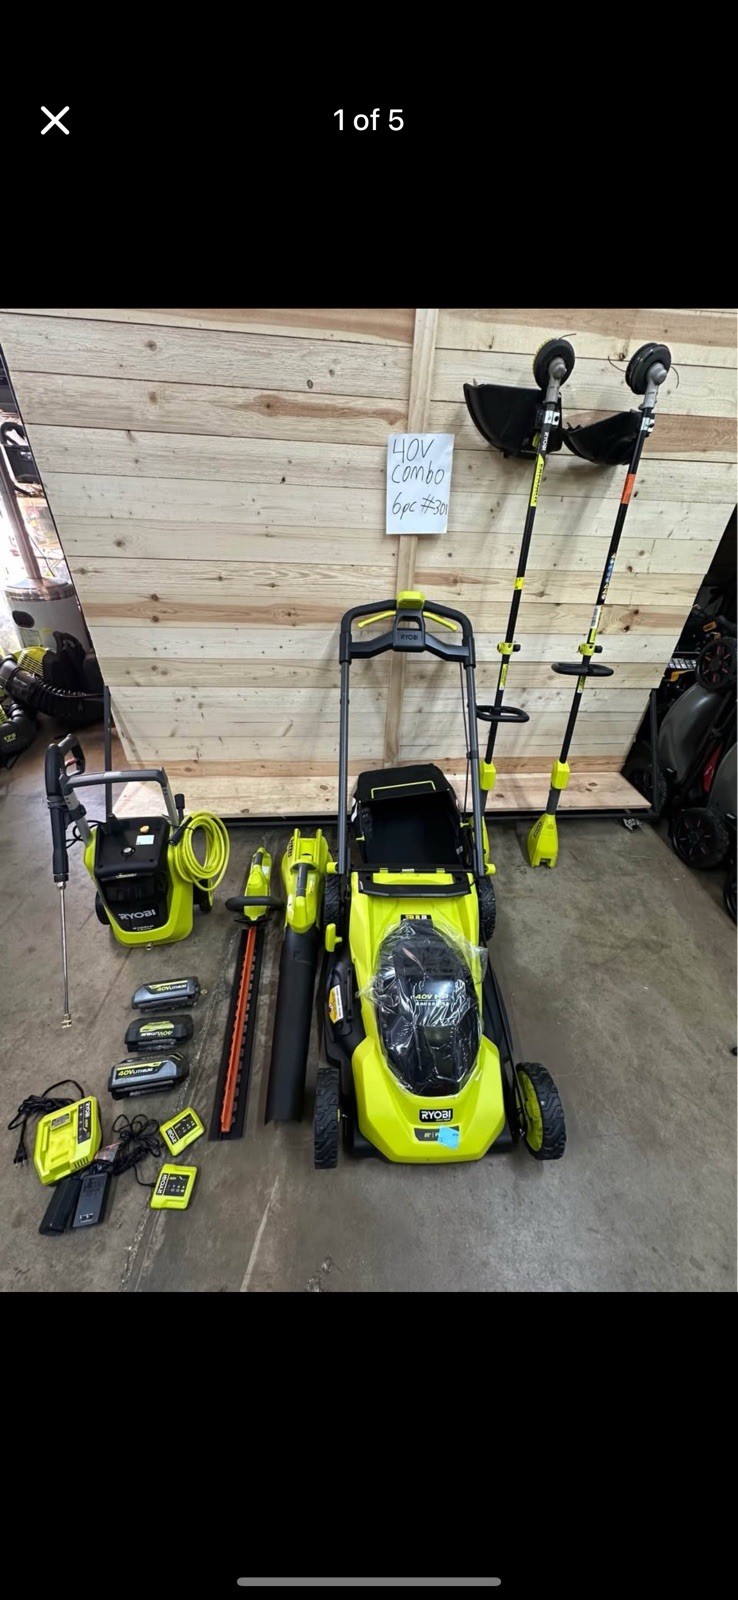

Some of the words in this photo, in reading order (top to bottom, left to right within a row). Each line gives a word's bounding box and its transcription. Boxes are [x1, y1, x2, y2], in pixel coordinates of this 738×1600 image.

[392, 438, 435, 463] 40V
[392, 491, 417, 520] 6pc
[118, 909, 156, 920] RYOBI
[420, 1110, 452, 1120] RYOBI
[157, 1174, 168, 1194] RYOBI
